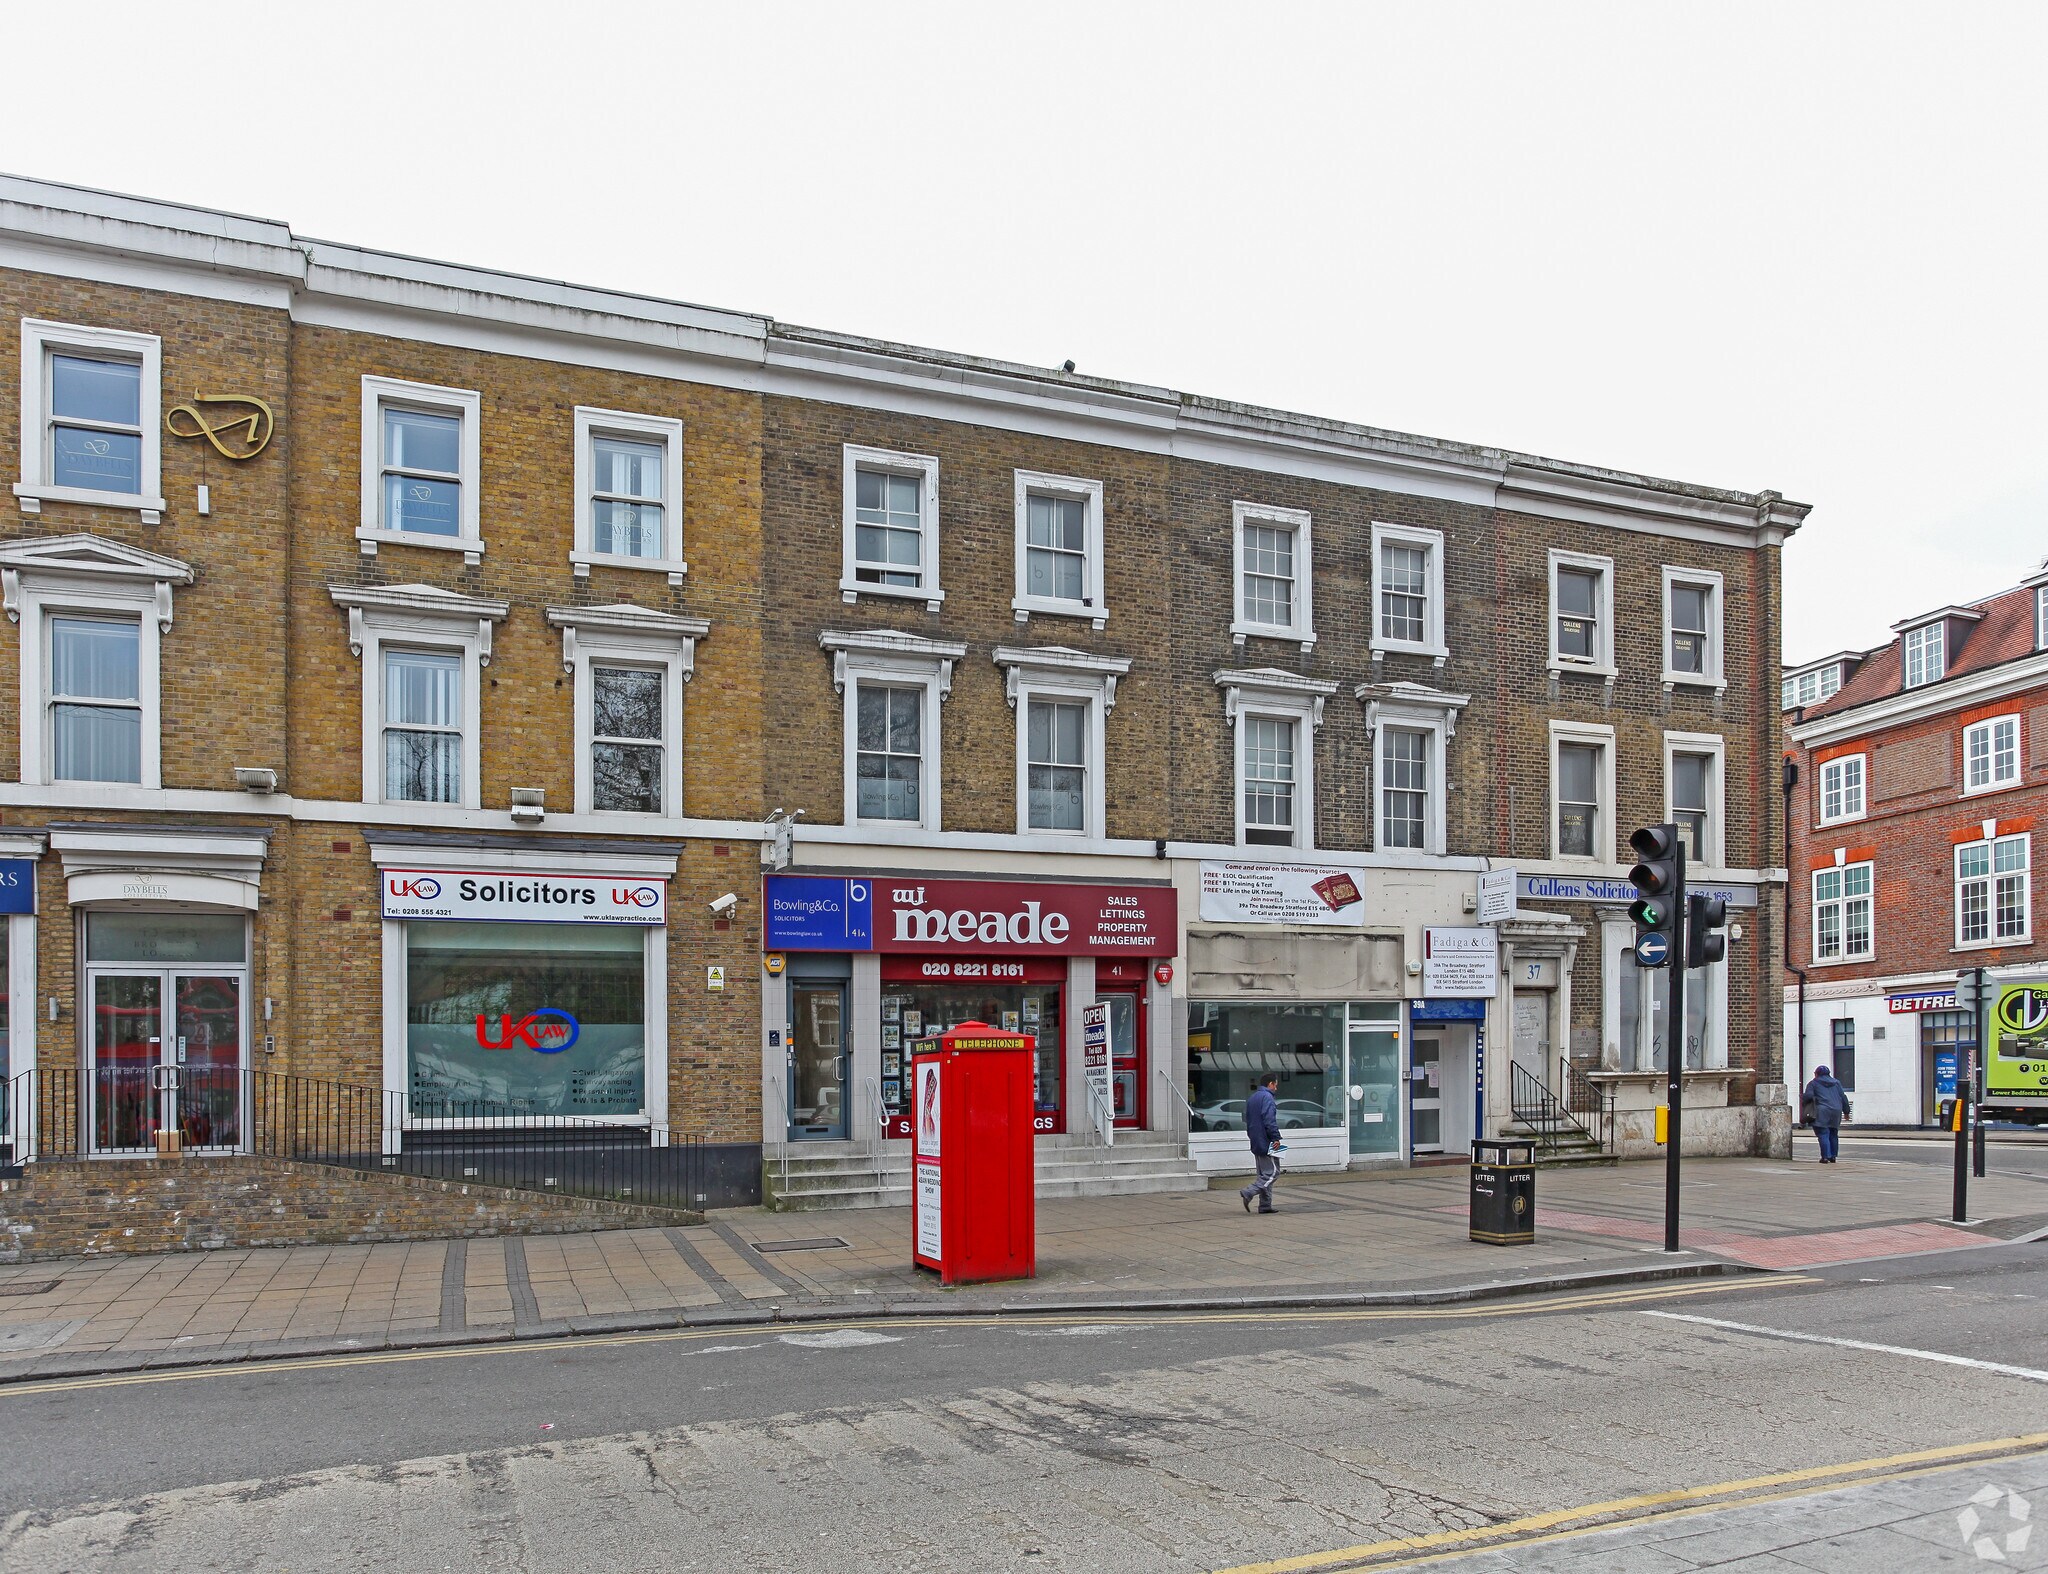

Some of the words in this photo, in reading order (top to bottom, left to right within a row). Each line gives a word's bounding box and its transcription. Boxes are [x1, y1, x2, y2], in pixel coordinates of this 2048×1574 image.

[1291, 866, 1318, 875] following
[123, 885, 168, 894] DAYBELLS
[390, 879, 420, 898] UK
[418, 885, 437, 893] LAW
[459, 879, 596, 905] Solicitors
[851, 879, 867, 902] b
[1528, 877, 1580, 897] Cullens
[612, 888, 641, 905] UK
[637, 894, 655, 902] LAW
[1261, 889, 1284, 897] Training
[1107, 896, 1138, 906] SALES
[387, 907, 400, 915] Tel:
[773, 899, 840, 914] Bowling&Co.
[1259, 904, 1285, 912] Broadway
[583, 914, 662, 922] www.uklawpractice.com
[1100, 909, 1145, 919] LETTINGS
[892, 901, 1070, 944] meade
[1097, 923, 1147, 933] PROPERTY
[1089, 935, 1156, 946] MANAGEMENT
[1433, 936, 1468, 949] Fadiga
[1471, 937, 1479, 947] &
[1481, 936, 1495, 947] Co
[922, 963, 950, 975] 020
[954, 963, 987, 976] 8221
[992, 964, 1024, 977] 8161
[1111, 966, 1122, 976] 41
[1527, 964, 1541, 980] 37
[1413, 1000, 1425, 1009] 39A
[1084, 1007, 1105, 1025] OPEN
[475, 1014, 541, 1050] UK
[534, 1025, 570, 1039] LAW
[1085, 1029, 1105, 1042] meade
[960, 1039, 1021, 1048] TELEPHONE
[1086, 1068, 1107, 1077] MANAGEMENT
[1093, 1078, 1107, 1086] LETTINGS
[1475, 1173, 1495, 1182] LITTER
[1509, 1174, 1531, 1182] LITTER
